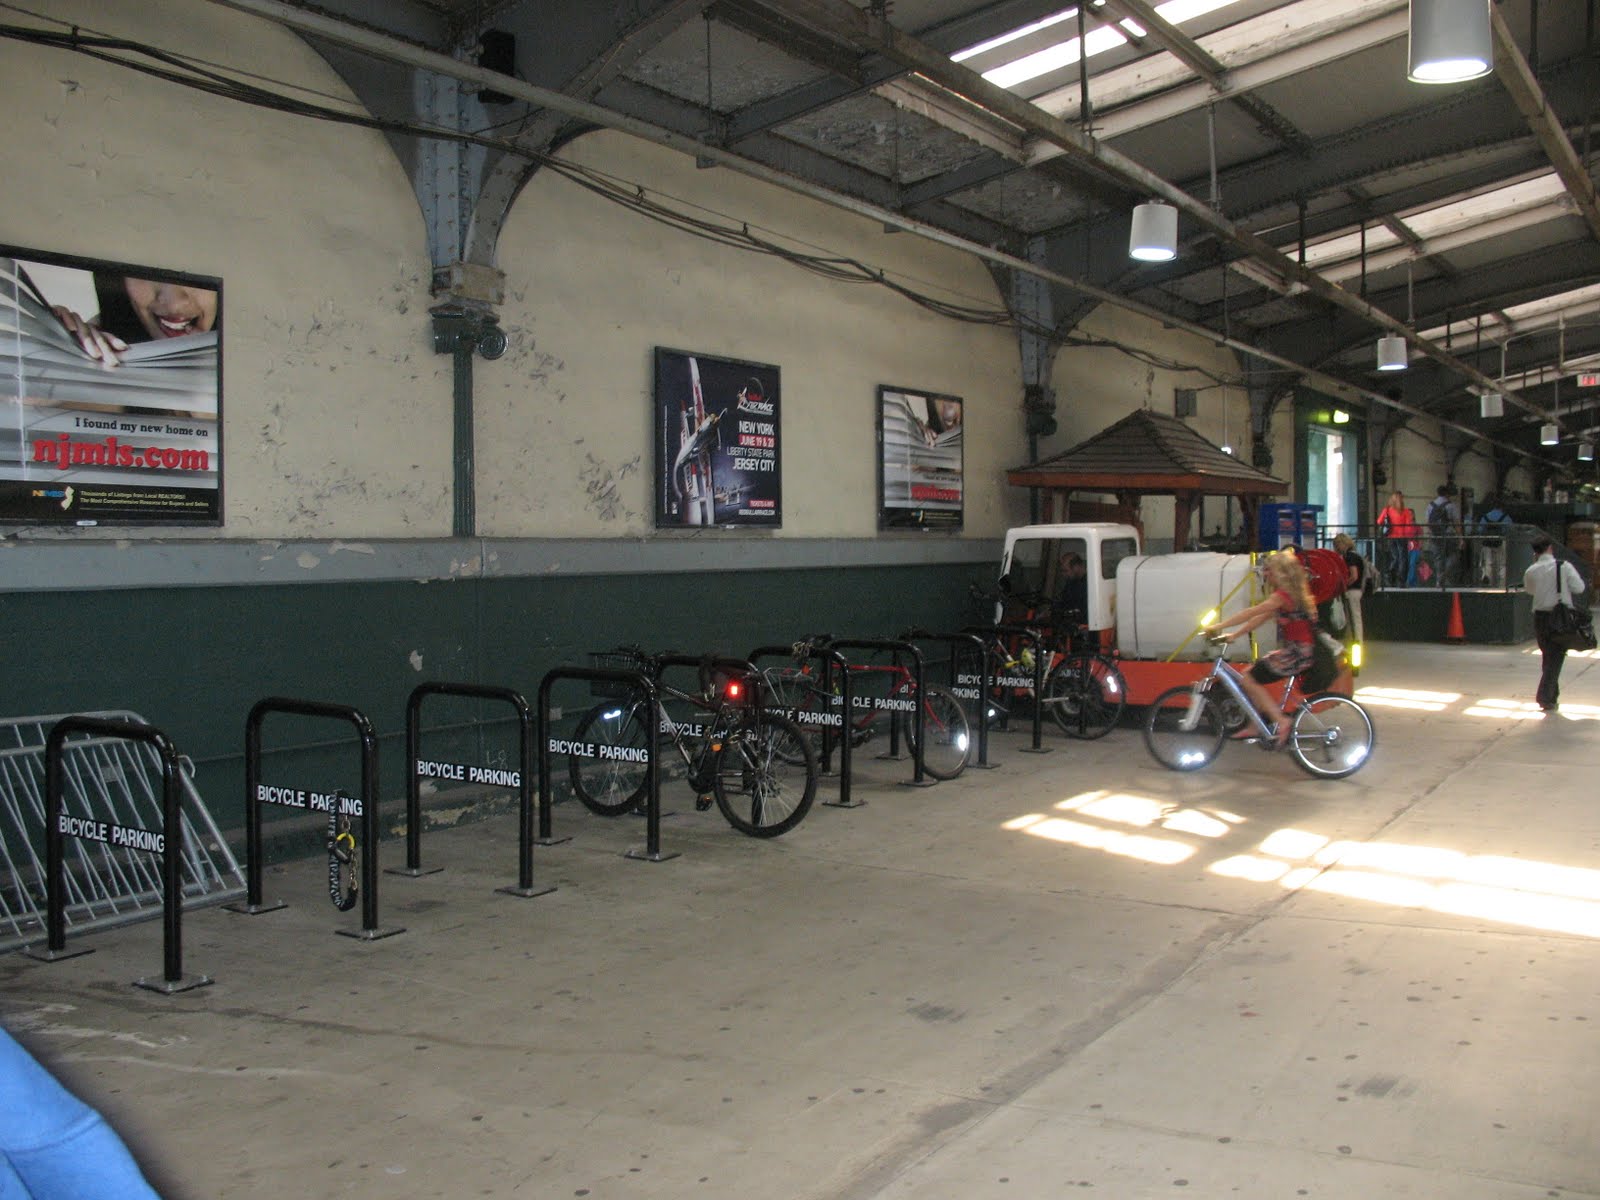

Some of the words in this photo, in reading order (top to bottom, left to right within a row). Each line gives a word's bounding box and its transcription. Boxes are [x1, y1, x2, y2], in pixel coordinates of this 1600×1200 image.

[75, 417, 80, 427] I
[83, 418, 117, 430] found
[120, 422, 136, 433] my
[140, 424, 163, 433] new
[166, 425, 193, 436] home
[196, 428, 208, 437] on
[739, 420, 756, 434] NEW
[757, 422, 774, 436] YORK
[740, 435, 755, 446] JUNE
[756, 436, 762, 447] 19
[763, 437, 767, 447] &
[32, 432, 209, 470] njmls.com
[727, 447, 747, 456] LIBERTY
[748, 447, 762, 457] STATE
[763, 448, 775, 458] PARK
[733, 457, 760, 471] JERSEY
[760, 459, 775, 472] CITY
[997, 676, 1034, 688] PARKING
[875, 698, 916, 711] PARKING
[798, 711, 843, 726] PARKING
[549, 739, 594, 758] BICYCLE
[600, 745, 648, 763] PARKING
[417, 760, 464, 781] BICYCLE
[469, 767, 521, 787] PARKING
[257, 784, 305, 808] BICYCLE
[59, 815, 107, 842] BICYCLE
[112, 825, 165, 853] PARKING
